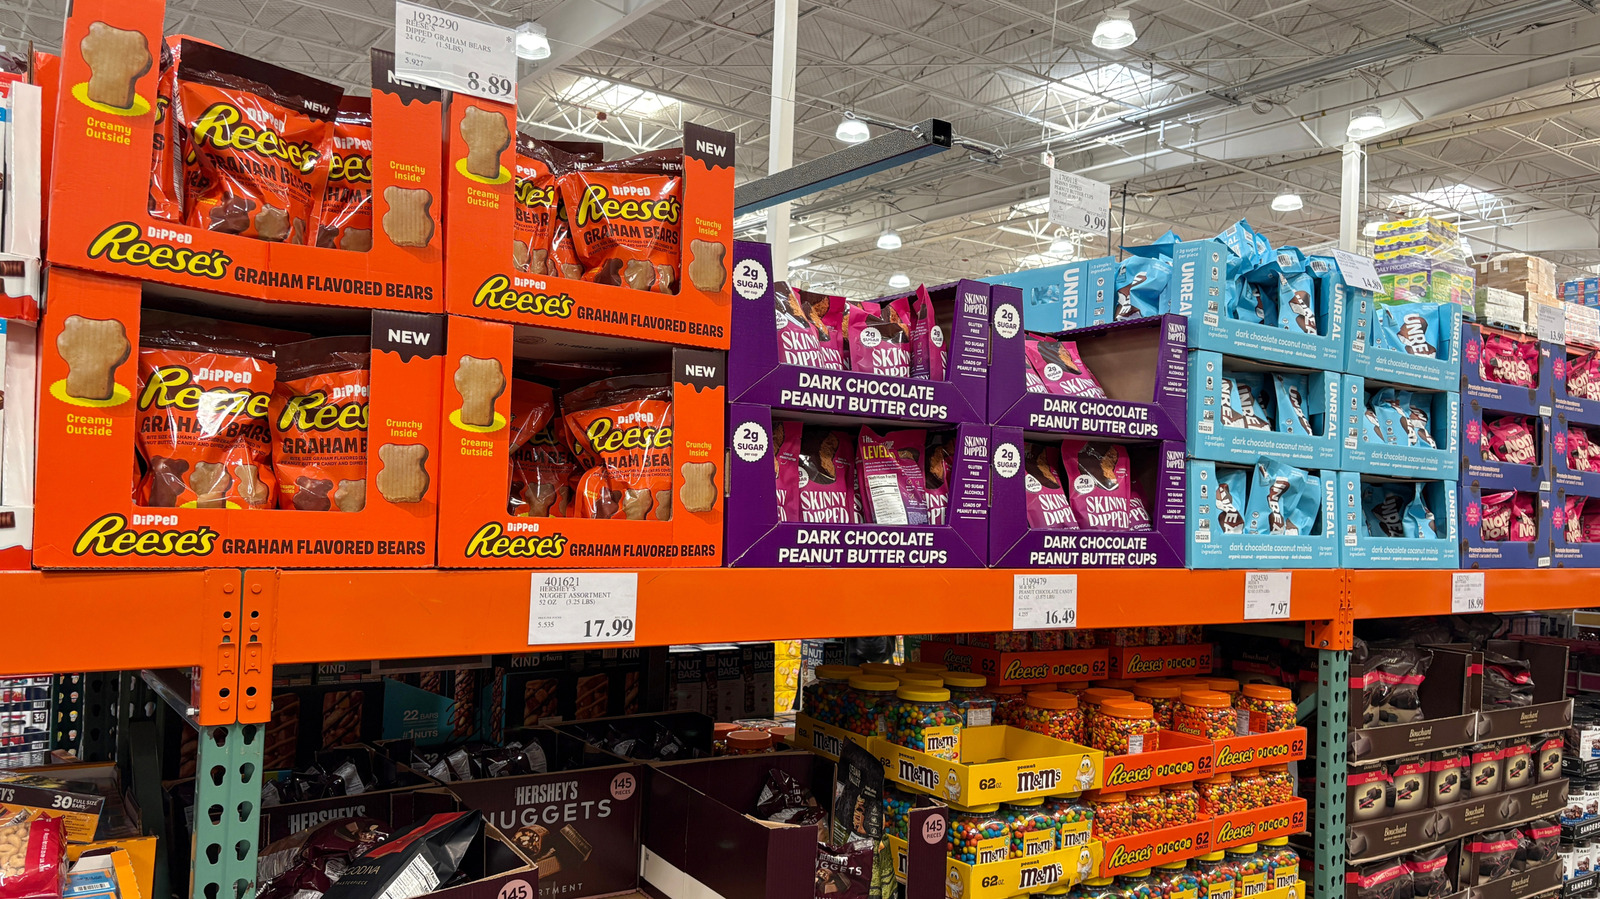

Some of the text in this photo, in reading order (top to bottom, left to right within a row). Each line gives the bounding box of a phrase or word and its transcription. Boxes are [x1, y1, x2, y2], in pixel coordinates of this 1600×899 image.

[413, 10, 459, 32] 1932290
[406, 26, 492, 52] DIPPED GRAHAM BEARS
[415, 36, 426, 44] OZ
[404, 57, 424, 67] 5.927
[467, 71, 513, 97] 8.89
[303, 100, 331, 116] NEW
[86, 116, 132, 136] Creamy
[86, 127, 131, 146] Outside
[696, 139, 727, 158] NEW
[389, 160, 426, 176] Crunchy
[394, 171, 422, 183] Inside
[467, 187, 500, 202] Creamy
[467, 196, 500, 210] Outside
[1084, 214, 1106, 231] 9.99
[88, 222, 232, 280] Reese's
[742, 266, 759, 281] 2g
[234, 266, 434, 301] GRAHAM FLAVORED BEARS
[736, 280, 764, 290] SUGAR
[964, 292, 988, 304] SKINNY
[963, 304, 988, 316] DIPPED
[1001, 310, 1014, 322] 2g
[1332, 283, 1344, 341] UNREAL
[577, 306, 724, 339] GRAHAM FLAVORED BEARS
[996, 322, 1018, 330] SUGAR
[388, 328, 431, 346] NEW
[1235, 328, 1250, 338] dark
[1250, 331, 1278, 344] chocolate
[1278, 336, 1301, 348] coconut
[1302, 340, 1317, 352] minis
[685, 364, 716, 378] NEW
[798, 373, 935, 401] DARK CHOCOLATE
[780, 390, 948, 420] PEANUT BUTTER CUPS
[1043, 398, 1148, 420] DARK CHOCOLATE
[1328, 382, 1338, 440] UNREAL
[66, 414, 114, 430] Creamy
[386, 418, 424, 431] Crunchy
[1030, 414, 1158, 436] PEANUT BUTTER CUPS
[66, 424, 114, 438] Outside
[390, 428, 419, 439] Inside
[743, 428, 759, 442] 2g
[282, 437, 360, 455] GRAHAM
[460, 438, 494, 450] Creamy
[685, 441, 713, 452] Crunchy
[737, 442, 764, 452] SUGAR
[460, 447, 494, 458] Outside
[688, 448, 709, 458] Inside
[1001, 448, 1014, 460] 2g
[800, 490, 847, 510] SKINNY
[1325, 480, 1335, 539] UNREAL
[72, 512, 220, 558] Reese's
[464, 522, 568, 558] Reese's
[796, 530, 934, 546] DARK CHOCOLATE
[222, 538, 426, 556] GRAHAM FLAVORED BEARS
[1044, 536, 1147, 550] DARK CHOCOLATE
[1230, 542, 1244, 552] dark
[1244, 544, 1274, 552] chocolate
[570, 544, 716, 558] GRAHAM FLAVORED BEARS
[778, 548, 948, 565] PEANUT BUTTER CUPS
[1030, 552, 1157, 566] PEANUT BUTTER CUPS
[544, 576, 580, 587] 401621
[1022, 578, 1047, 586] 1199479
[1270, 602, 1288, 614] 7.97
[1468, 598, 1484, 610] 18.99
[1046, 610, 1075, 624] 16.49
[584, 618, 633, 638] 17.99
[511, 655, 540, 668] KIND
[717, 656, 740, 668] NUT
[1092, 660, 1106, 673] 62
[717, 666, 740, 676] BARS
[34, 712, 46, 720] 36
[403, 710, 439, 722] 22 BARS
[1408, 725, 1434, 739] Bouchard
[1198, 756, 1212, 770] 62
[1216, 745, 1255, 768] Reese's
[1106, 762, 1152, 788] Reese's
[612, 777, 632, 790] 145
[515, 781, 579, 806] HERSHEY'S
[52, 795, 72, 809] 30
[1464, 804, 1486, 818] Bouchard
[925, 820, 944, 834] 145
[1216, 820, 1256, 844] Reese's
[1383, 823, 1408, 837] Bouchard
[1196, 832, 1210, 844] 62
[1108, 844, 1152, 870] Reese's
[982, 876, 998, 888] 62
[1570, 878, 1594, 892] SANDERS
